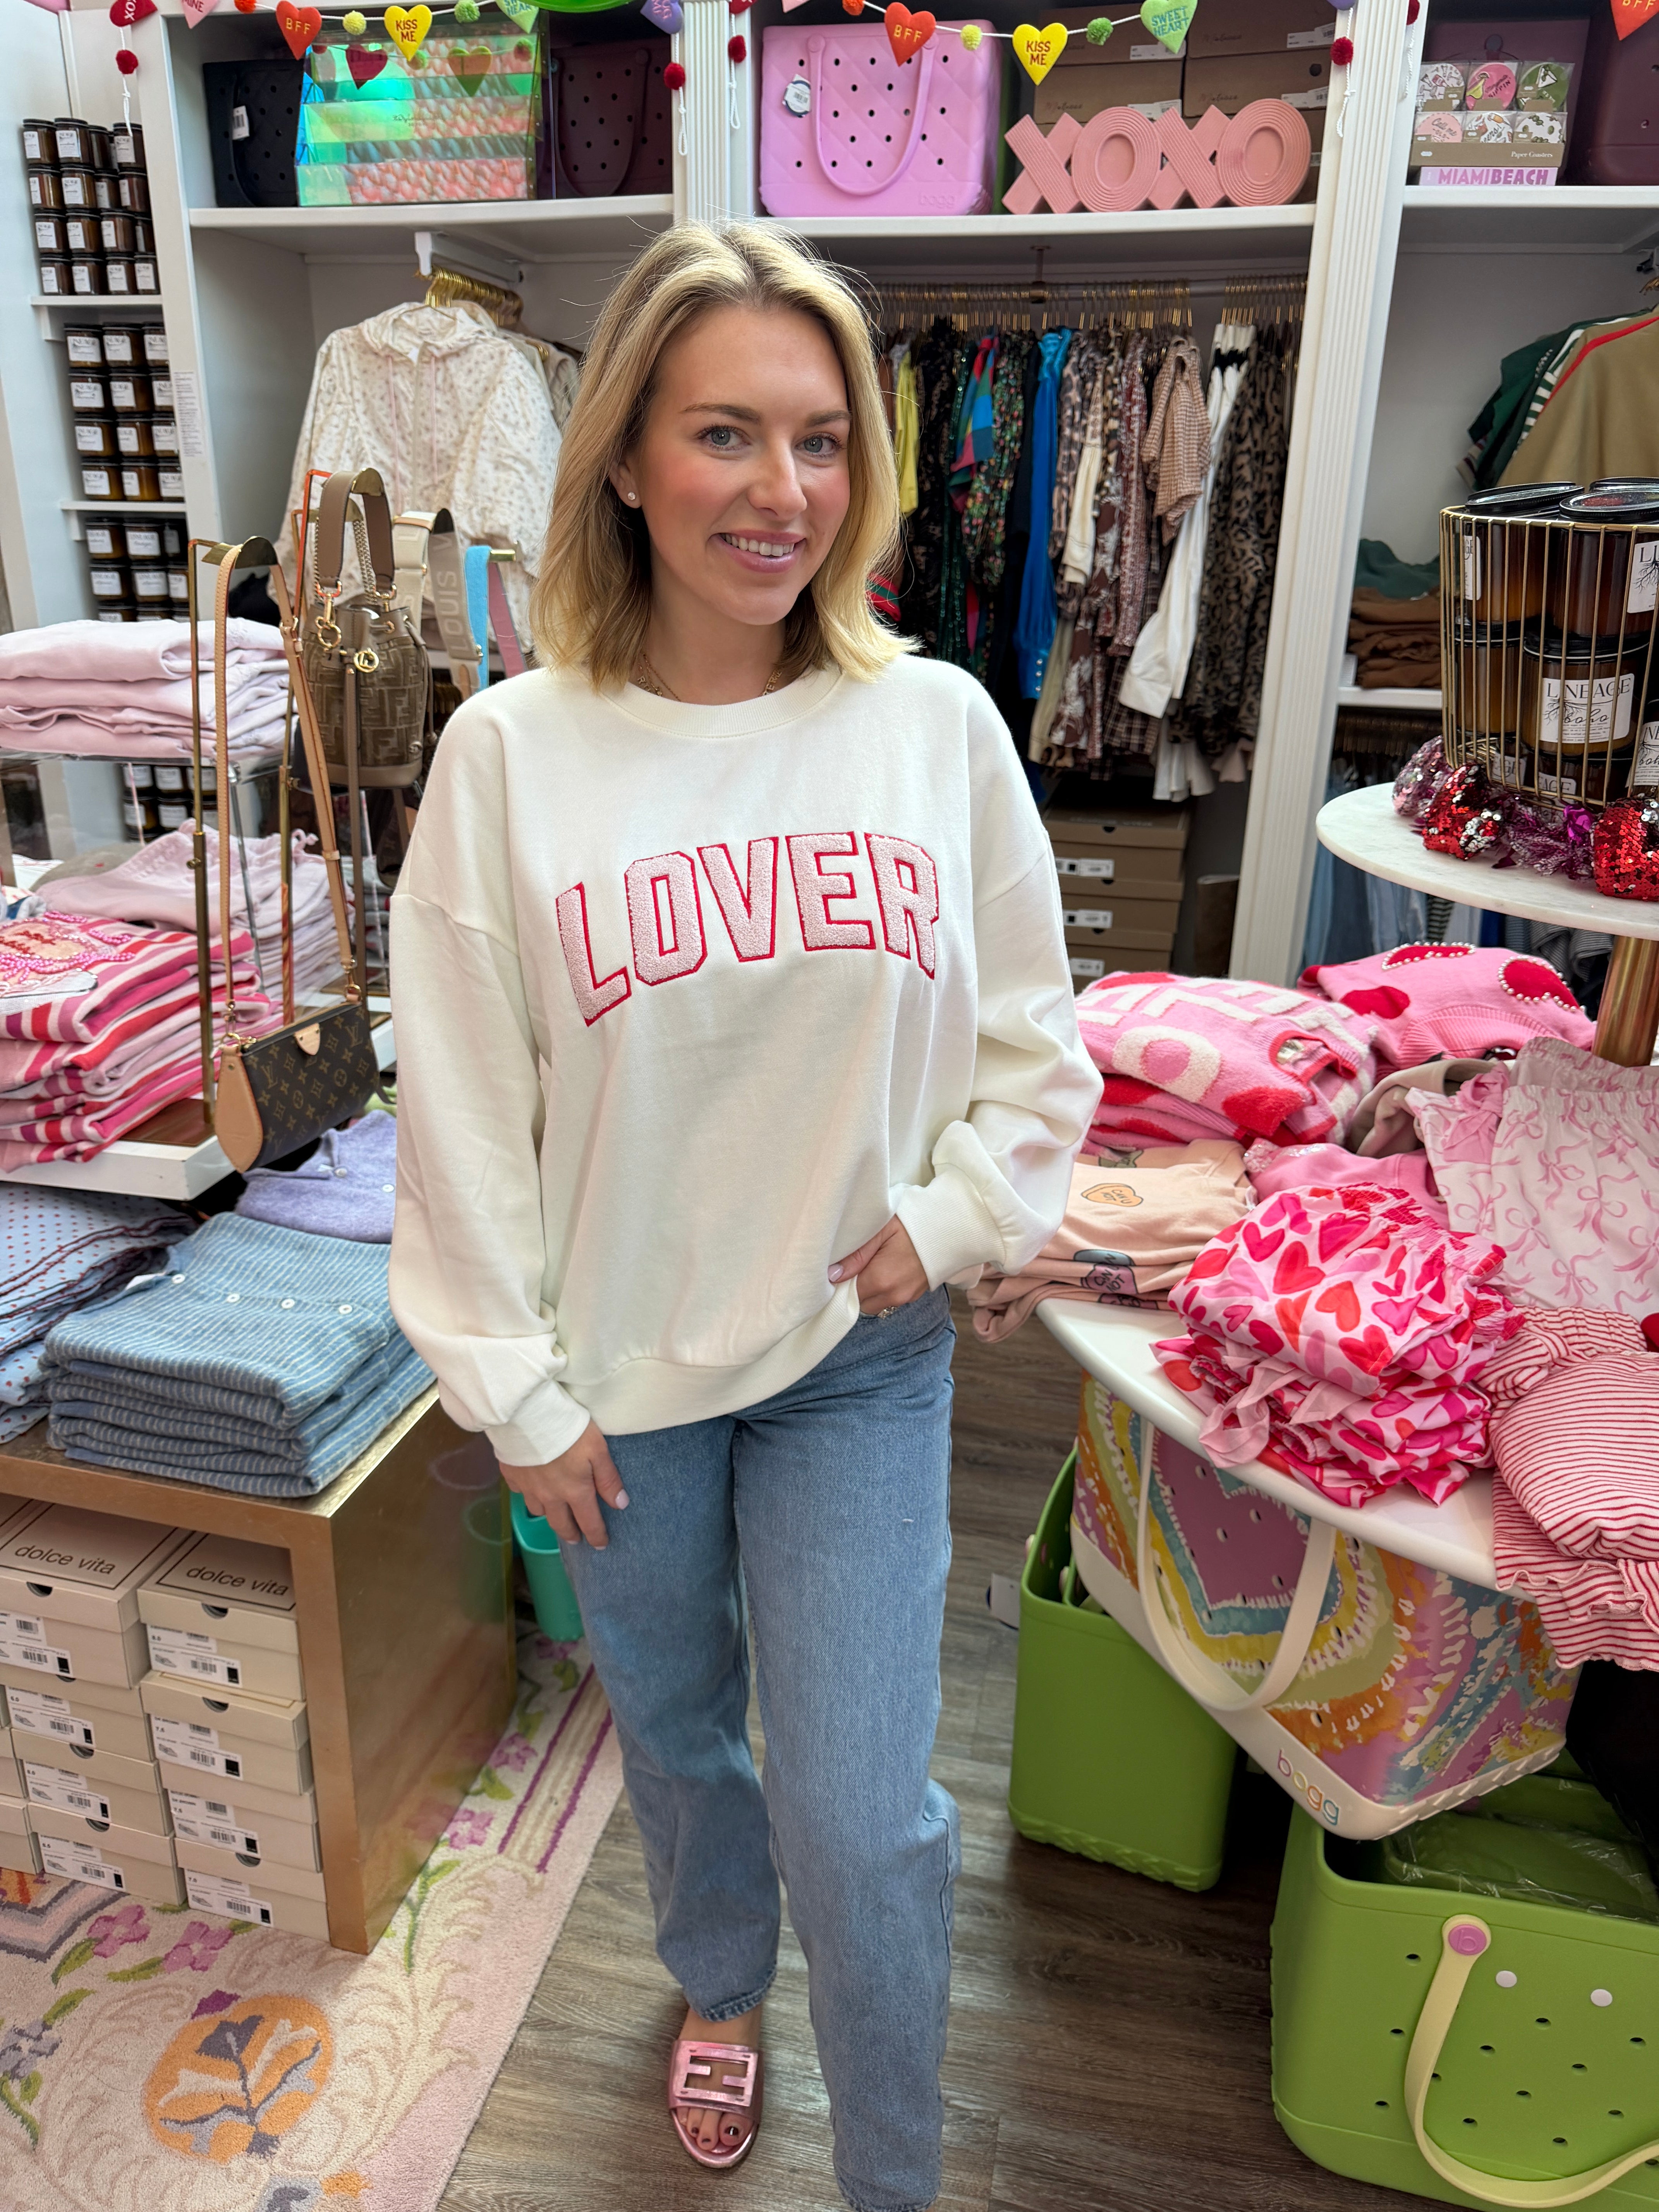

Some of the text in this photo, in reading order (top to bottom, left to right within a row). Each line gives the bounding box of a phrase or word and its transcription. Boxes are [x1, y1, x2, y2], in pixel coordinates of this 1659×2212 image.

[285, 17, 311, 34] BFF
[395, 19, 418, 30] KISS
[1151, 7, 1188, 27] SWEET
[401, 30, 416, 42] ME
[894, 24, 922, 43] BFF
[1154, 18, 1190, 37] HEART
[1026, 41, 1051, 53] KISS
[1029, 53, 1046, 66] ME
[1002, 98, 1311, 215] XOXO
[1511, 151, 1528, 159] Paper
[437, 570, 471, 652] LOUIS
[1546, 678, 1631, 699] LNEAGE
[556, 831, 939, 1027] LOVER
[14, 1545, 116, 1575] dolce vita
[186, 1566, 289, 1596] dolce vita
[1277, 1748, 1340, 1826] bogg
